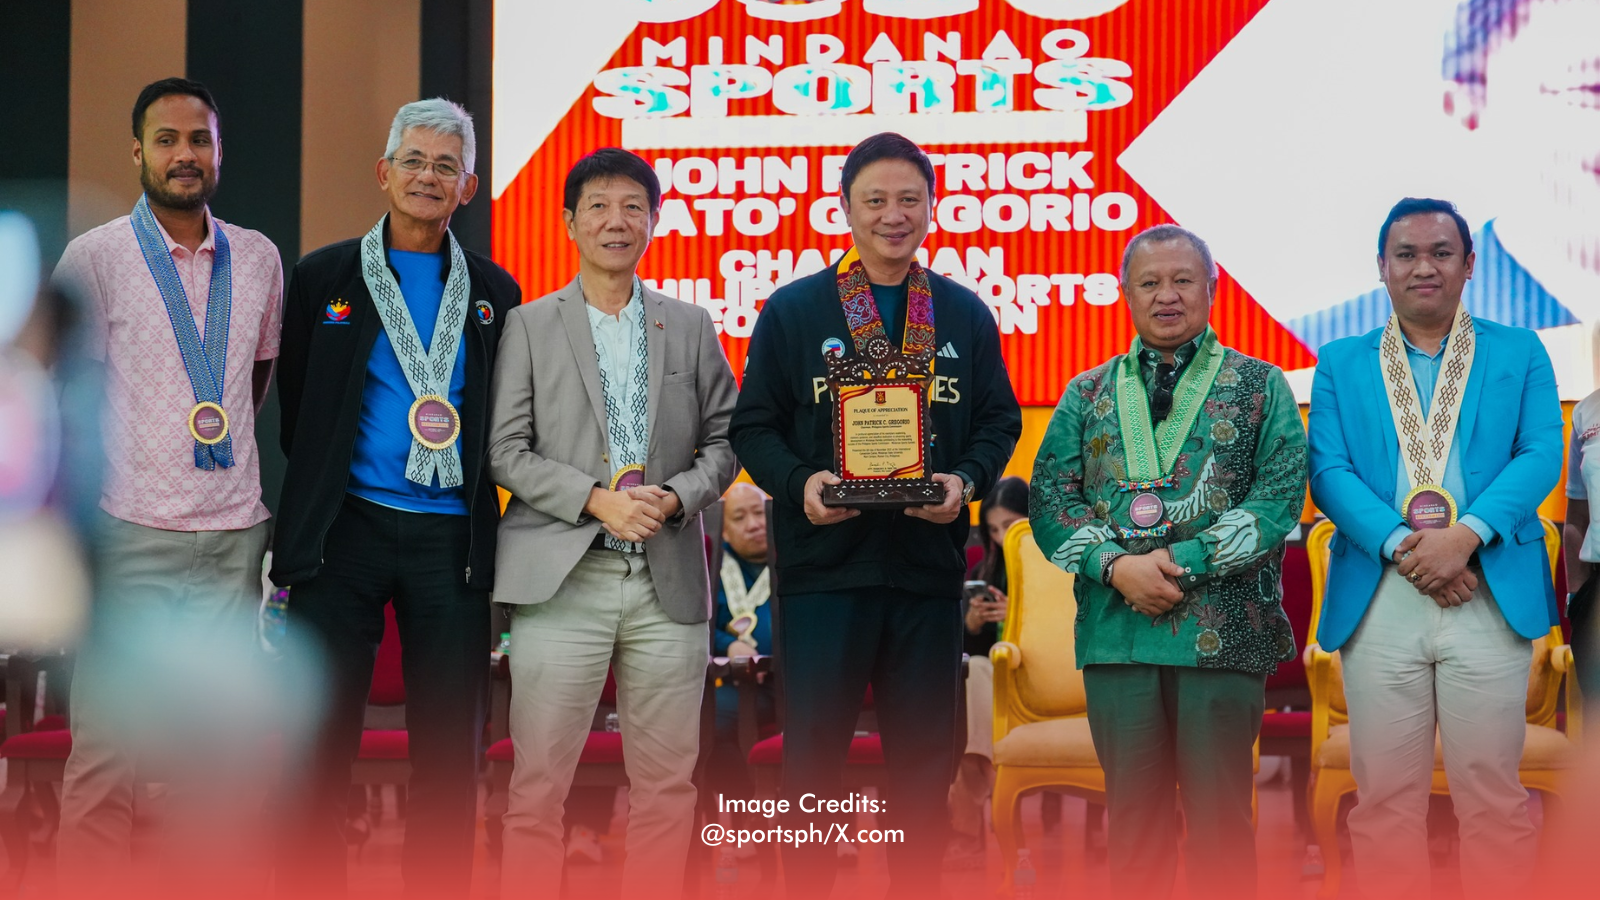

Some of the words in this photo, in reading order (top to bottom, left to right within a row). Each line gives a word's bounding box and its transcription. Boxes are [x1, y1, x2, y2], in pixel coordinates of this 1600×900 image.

[641, 28, 1090, 67] MINDANAO
[592, 57, 1134, 119] SPORTS
[809, 192, 1138, 237] GGORIO
